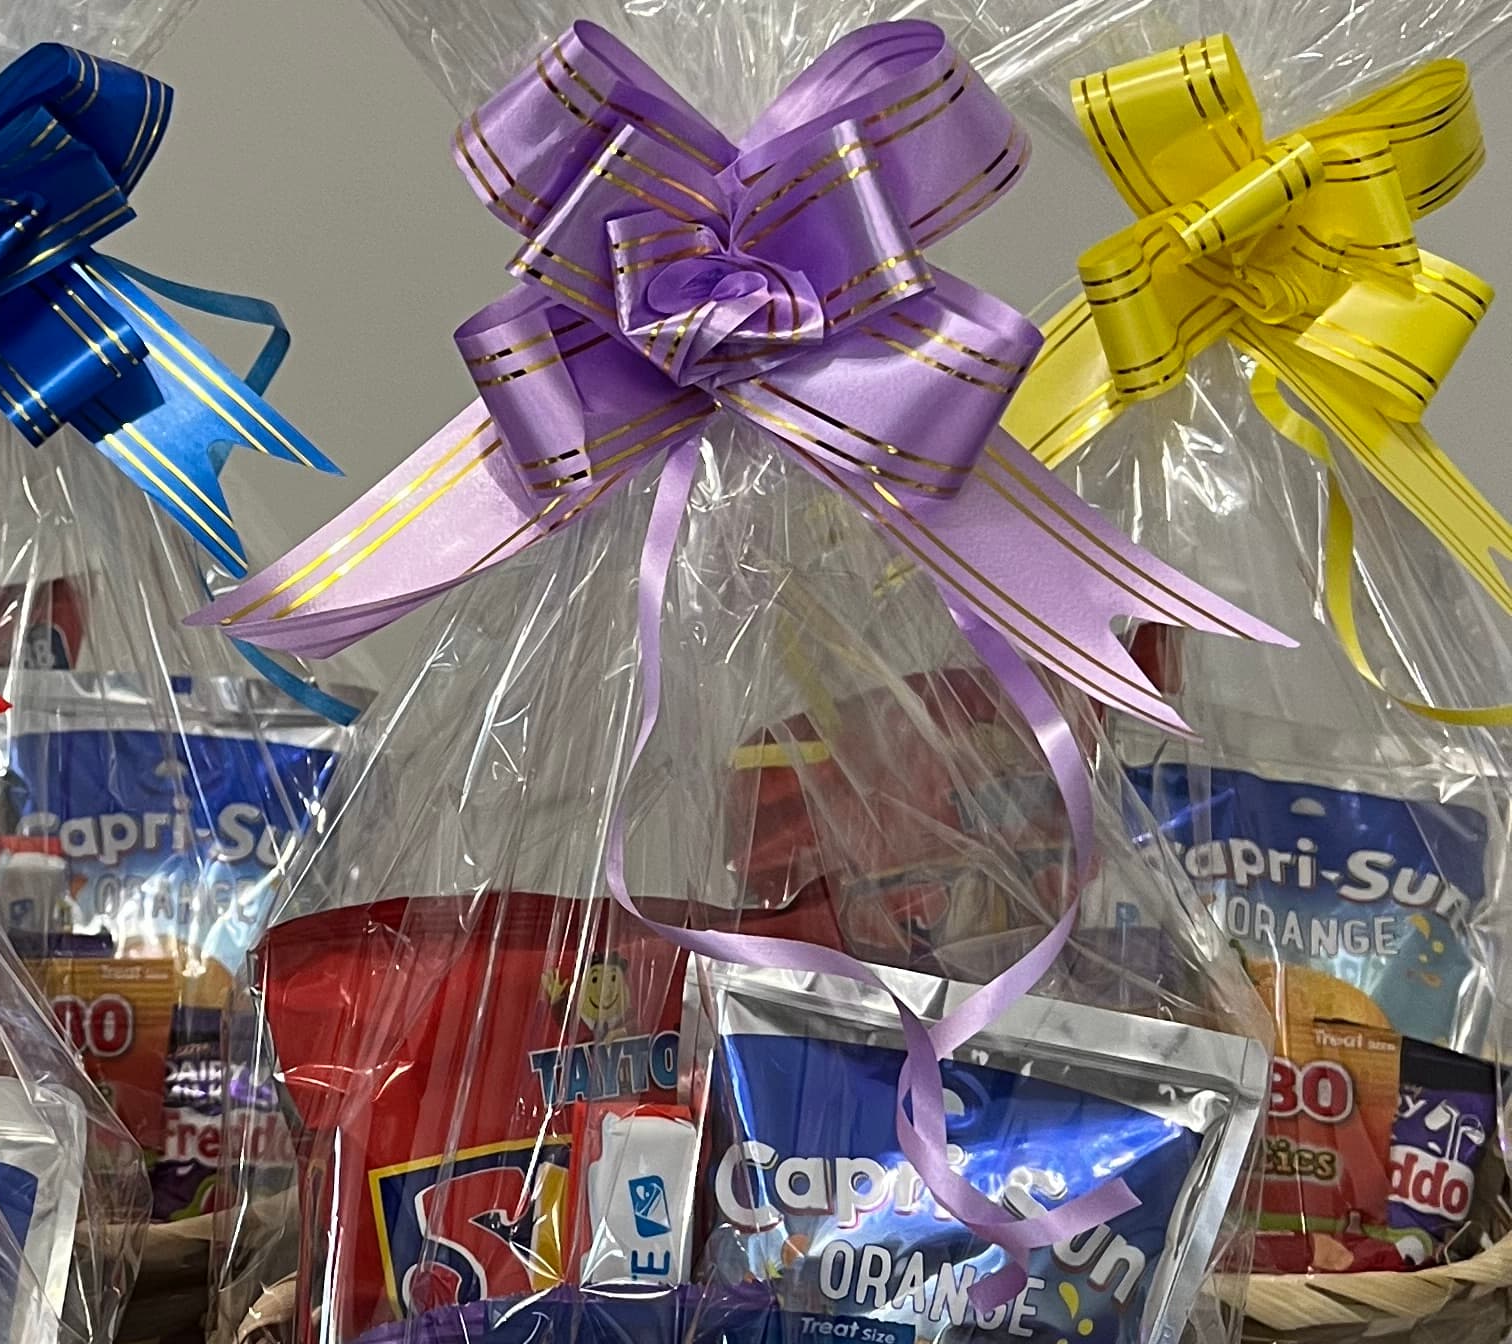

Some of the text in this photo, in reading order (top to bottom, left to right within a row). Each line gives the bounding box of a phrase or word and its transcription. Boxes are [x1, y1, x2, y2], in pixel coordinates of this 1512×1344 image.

[18, 794, 298, 868] apri-Su
[1178, 837, 1472, 942] apri-Sun
[1226, 895, 1400, 958] ORANGE
[529, 1030, 681, 1107] TAYTO
[818, 1239, 1046, 1340] ORANE
[801, 1317, 896, 1344] Treat size
